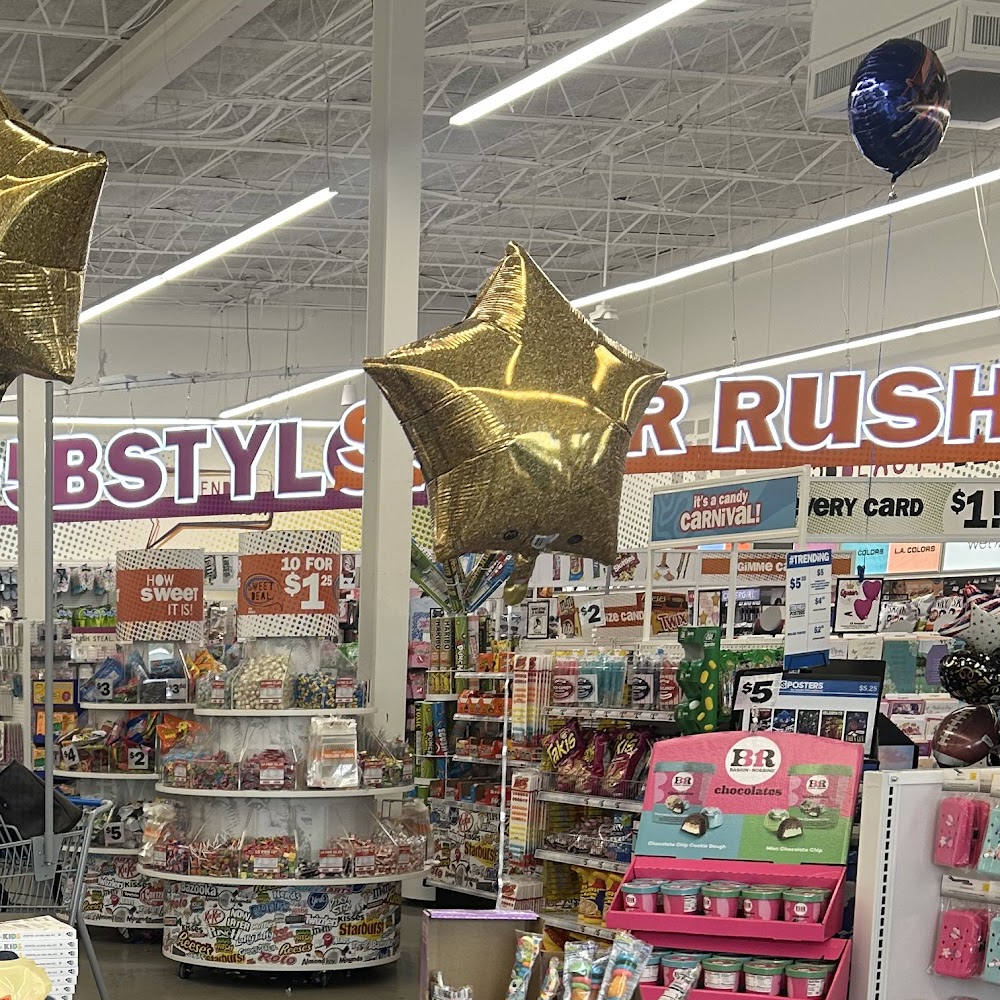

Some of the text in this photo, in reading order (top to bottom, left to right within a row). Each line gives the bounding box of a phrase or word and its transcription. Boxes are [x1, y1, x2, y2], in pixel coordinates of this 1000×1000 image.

[693, 489, 749, 509] it's a candy
[907, 545, 936, 554] COLORS
[280, 556, 333, 571] 10 FOR
[788, 551, 830, 565] #TRENDING
[146, 574, 174, 587] HOW
[248, 581, 274, 591] SWEET
[168, 604, 193, 616] IT IS!
[581, 604, 600, 624] $2
[97, 682, 111, 696] $3
[741, 680, 774, 704] $5
[787, 682, 824, 690] POSTERS
[859, 684, 878, 693] $5.25
[547, 731, 577, 766] Takis
[130, 752, 146, 766] $2
[714, 785, 783, 797] chocolates
[106, 827, 122, 840] $5
[339, 921, 384, 936] Starburst
